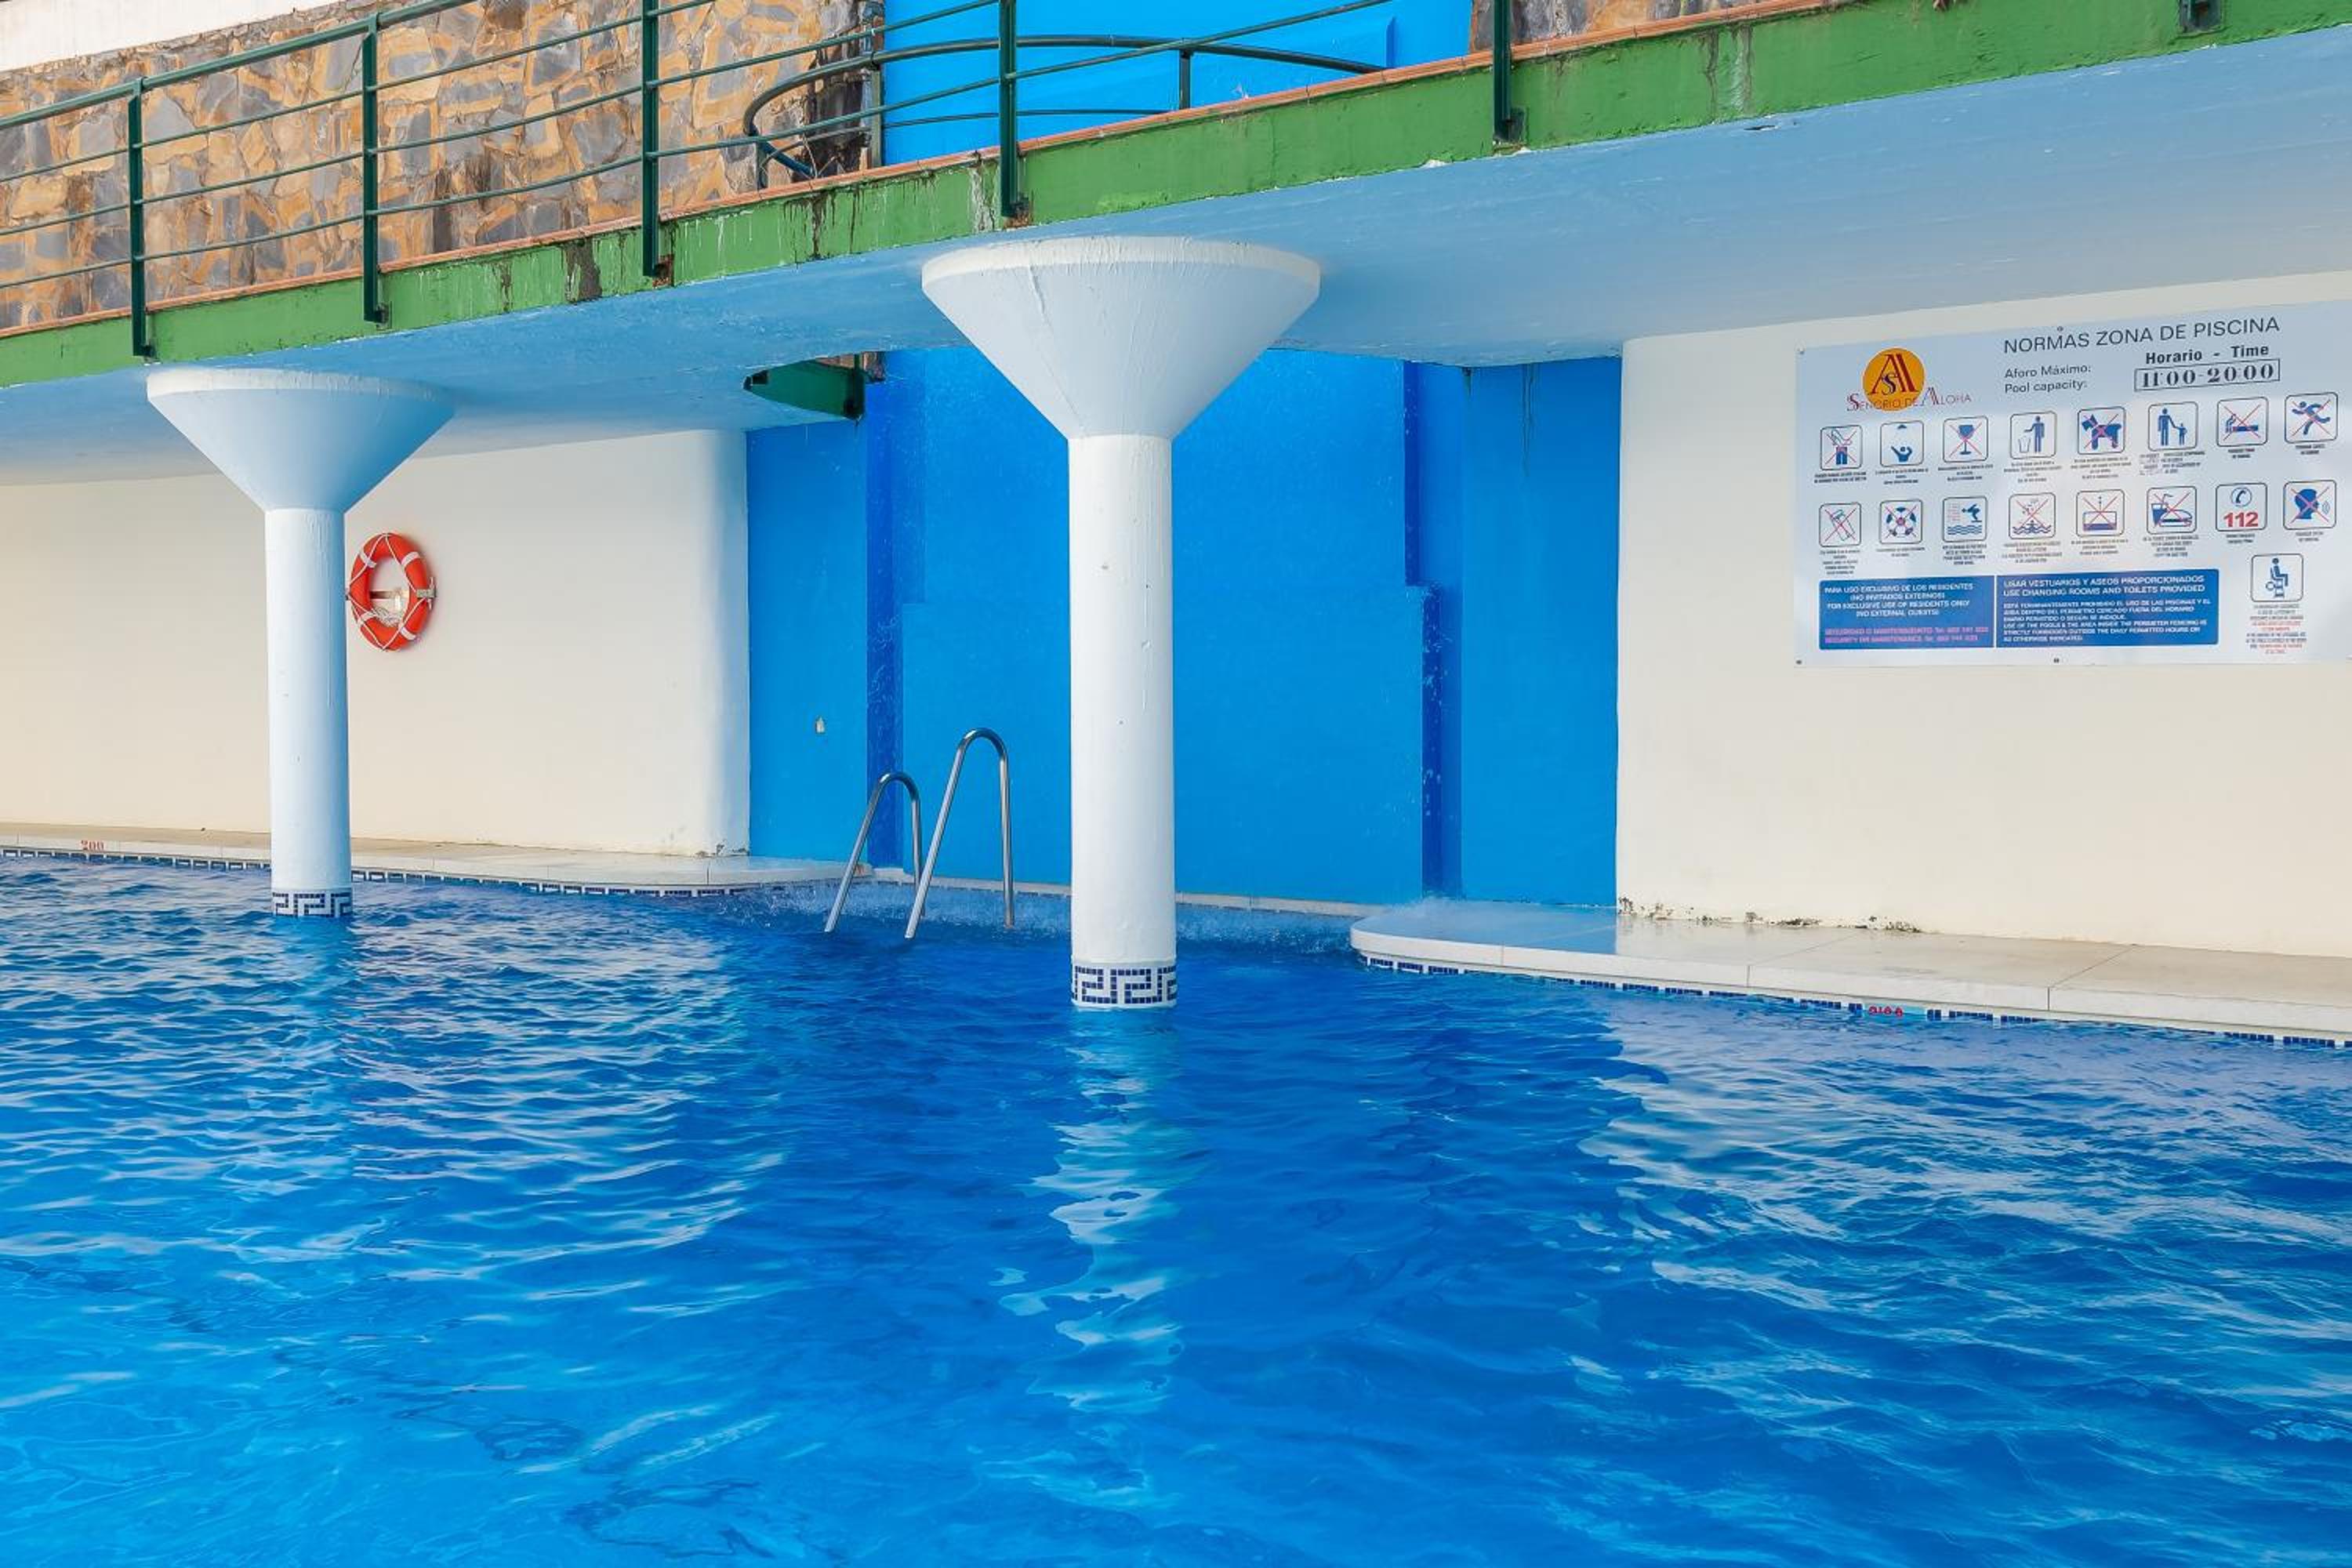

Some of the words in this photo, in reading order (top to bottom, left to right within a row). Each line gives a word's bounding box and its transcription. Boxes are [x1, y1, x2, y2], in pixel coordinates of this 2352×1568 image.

[2004, 333, 2089, 354] NORMAS
[2096, 328, 2153, 347] ZONA
[2160, 324, 2187, 340] DE
[2194, 317, 2280, 338] PISCINA
[2146, 350, 2202, 364] Horario
[2230, 344, 2269, 358] Time
[2004, 368, 2038, 379] Aforo
[2041, 365, 2091, 376] Máximo:
[2005, 382, 2030, 394] Pool
[2033, 379, 2088, 392] capacity:
[2223, 512, 2259, 528] 112
[2029, 579, 2081, 587] VESTUARIOS
[2121, 575, 2205, 584] PROPORCIONADOS
[2160, 584, 2205, 593] PROVIDED
